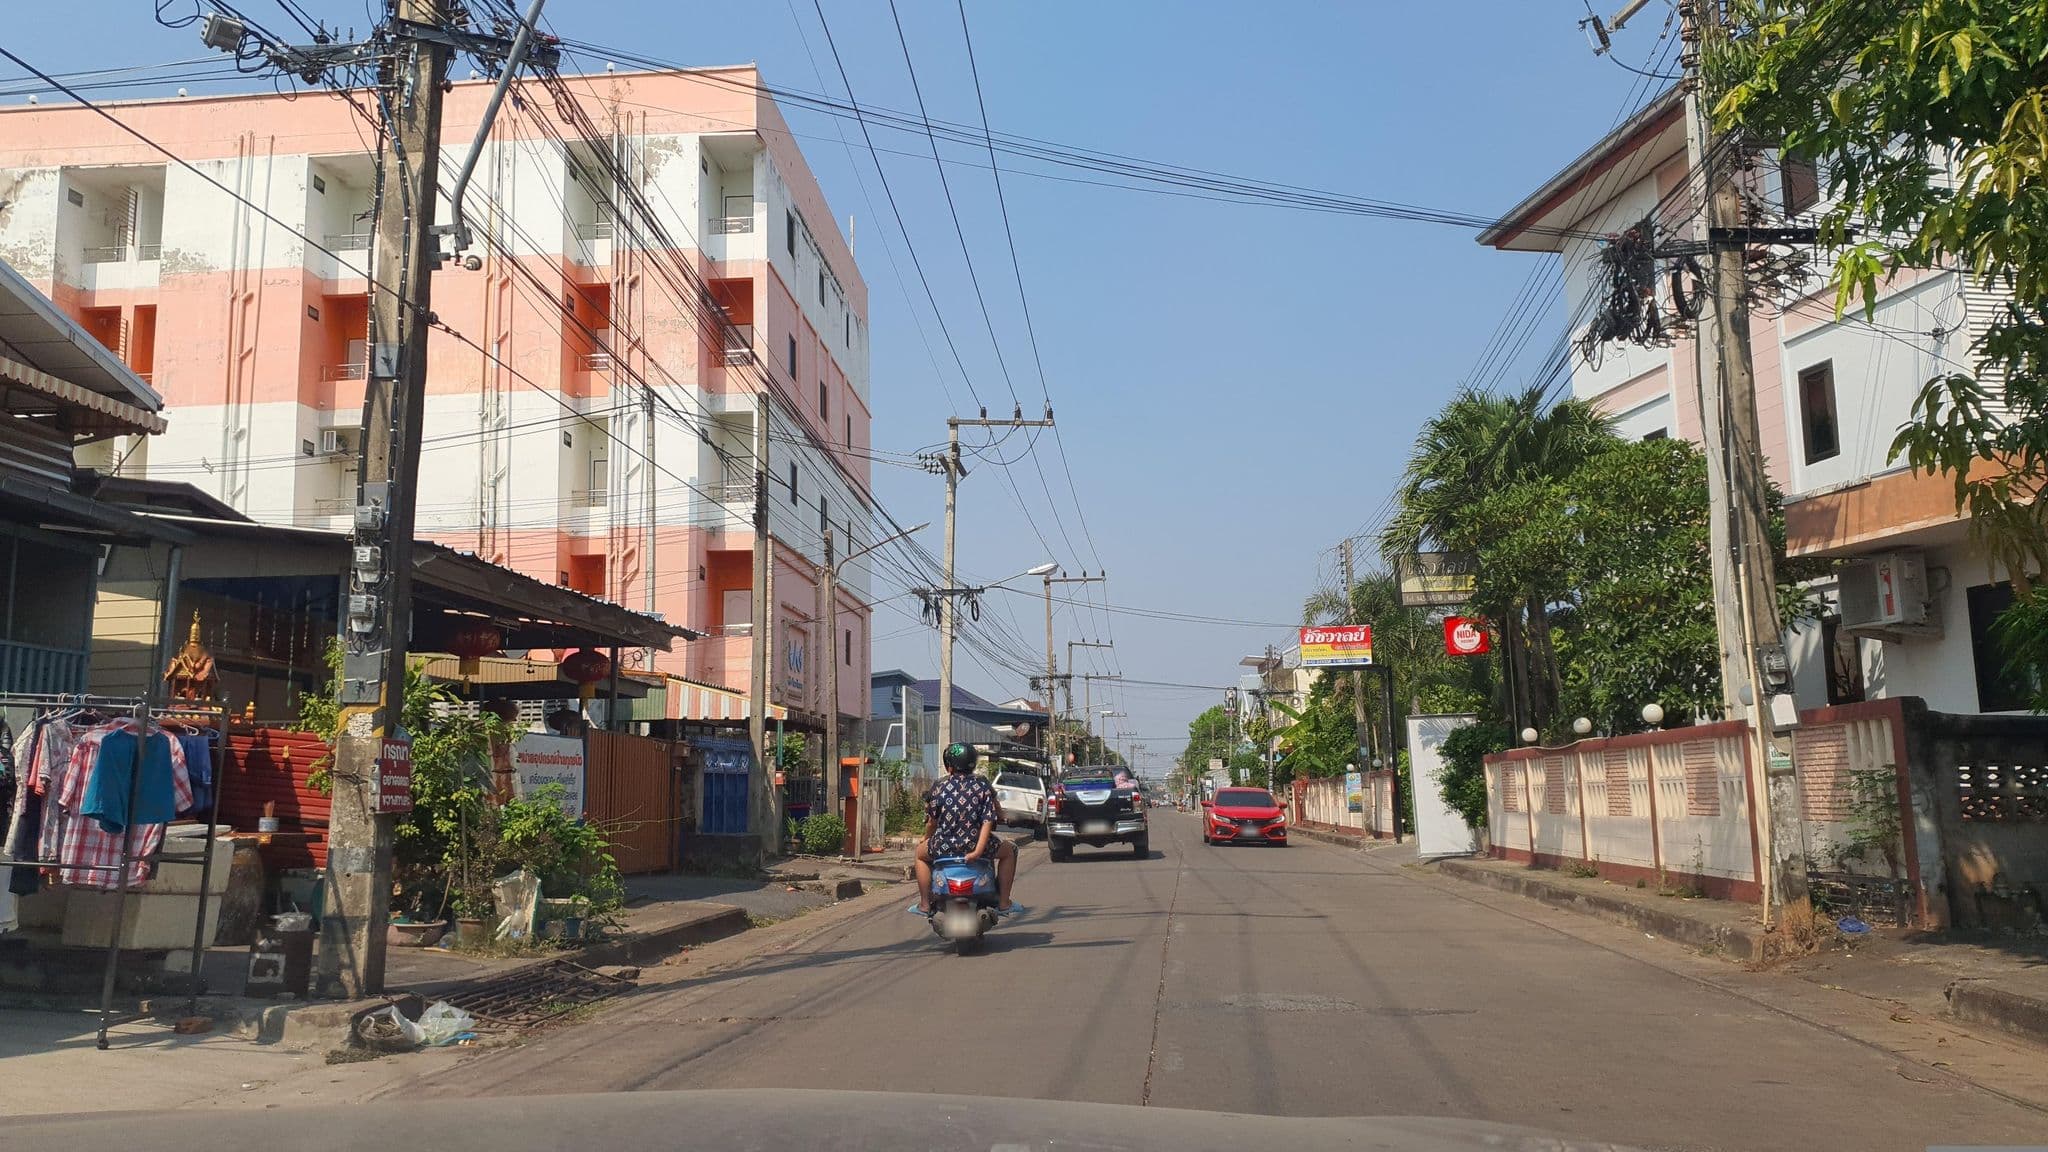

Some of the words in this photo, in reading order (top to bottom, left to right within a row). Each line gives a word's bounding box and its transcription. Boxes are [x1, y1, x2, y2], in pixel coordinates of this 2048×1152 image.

[1303, 626, 1366, 644] ชัชวาลย์
[1456, 630, 1477, 639] NIDA
[383, 743, 409, 768] กรุณา
